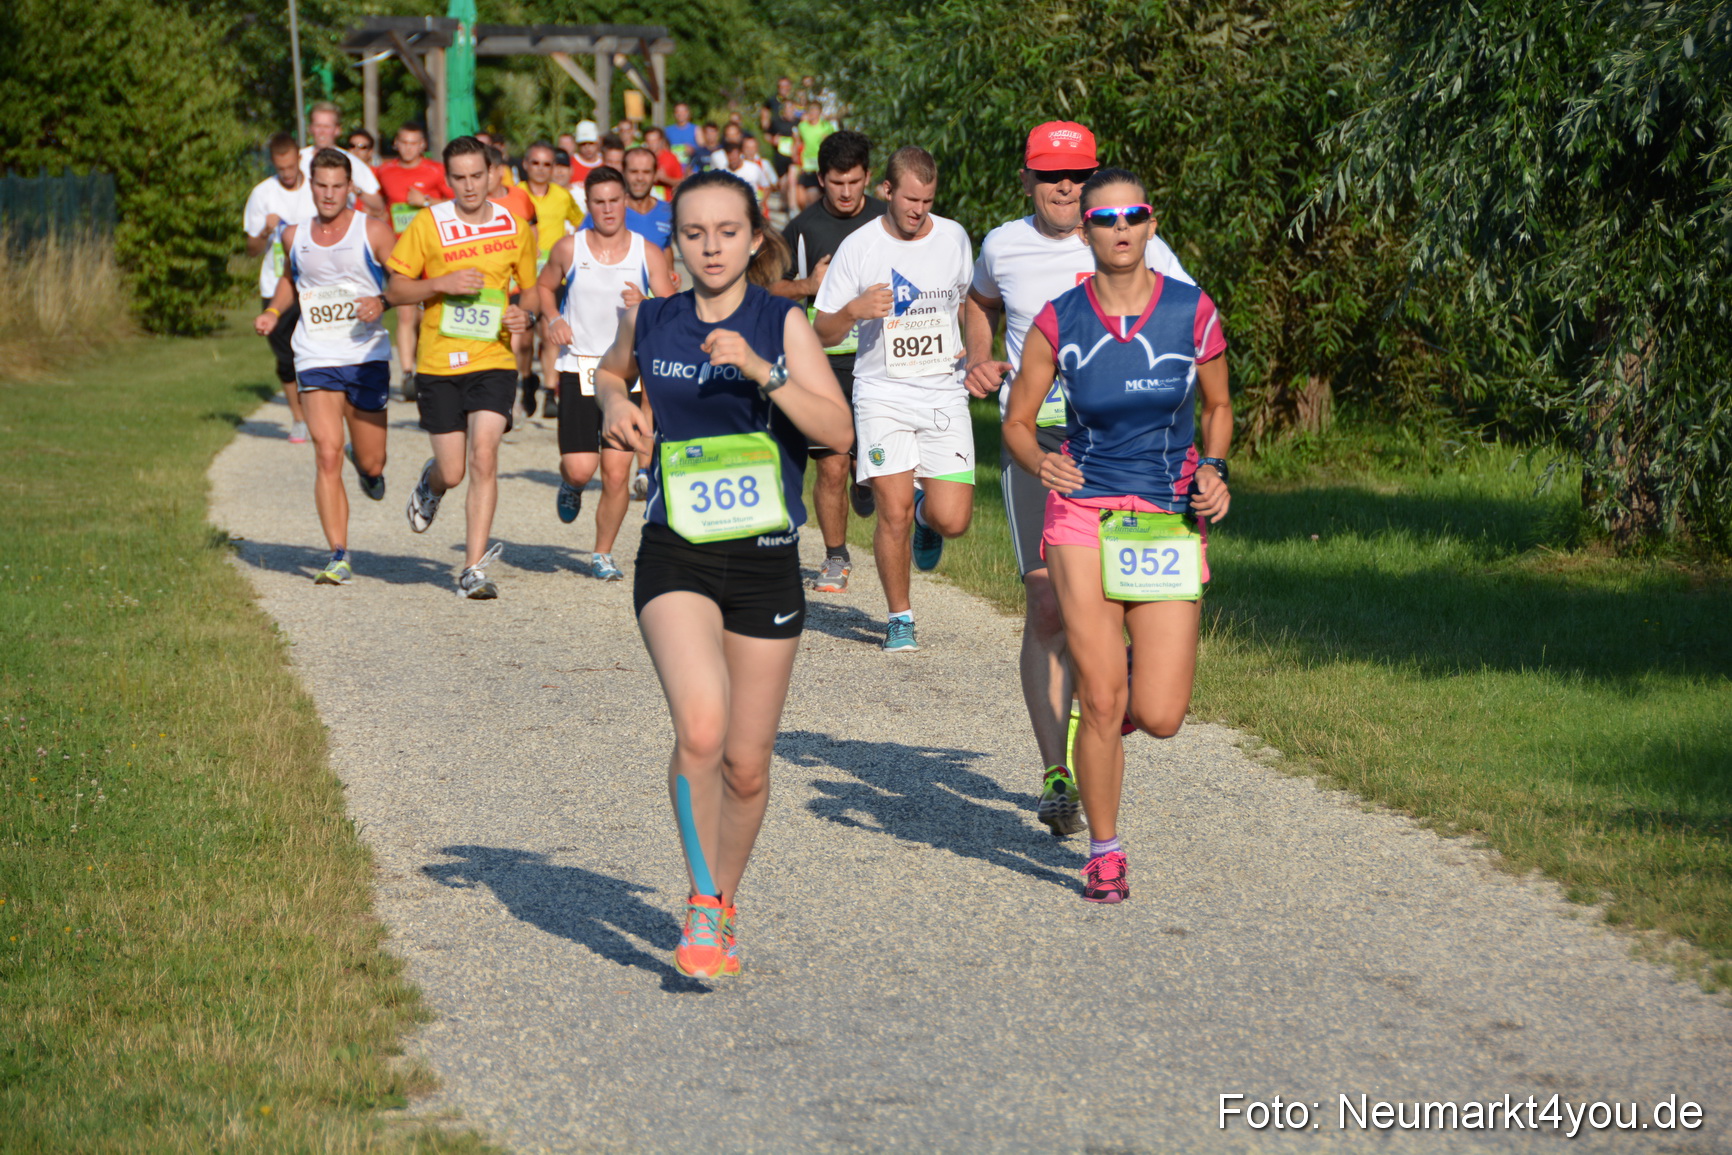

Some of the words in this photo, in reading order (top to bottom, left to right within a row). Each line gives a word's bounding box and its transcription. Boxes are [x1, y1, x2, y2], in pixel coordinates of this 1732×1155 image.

[443, 247, 479, 263] MAX
[483, 239, 518, 255] BÖGL
[310, 302, 356, 324] 8922
[453, 306, 490, 326] 935
[904, 306, 937, 316] Team
[886, 318, 941, 330] df-sports
[893, 333, 942, 358] 8921
[653, 359, 697, 378] EURO
[889, 357, 952, 368] www.df-sports.de
[1125, 379, 1159, 391] MCM
[689, 475, 760, 513] 368
[1118, 547, 1181, 576] 952
